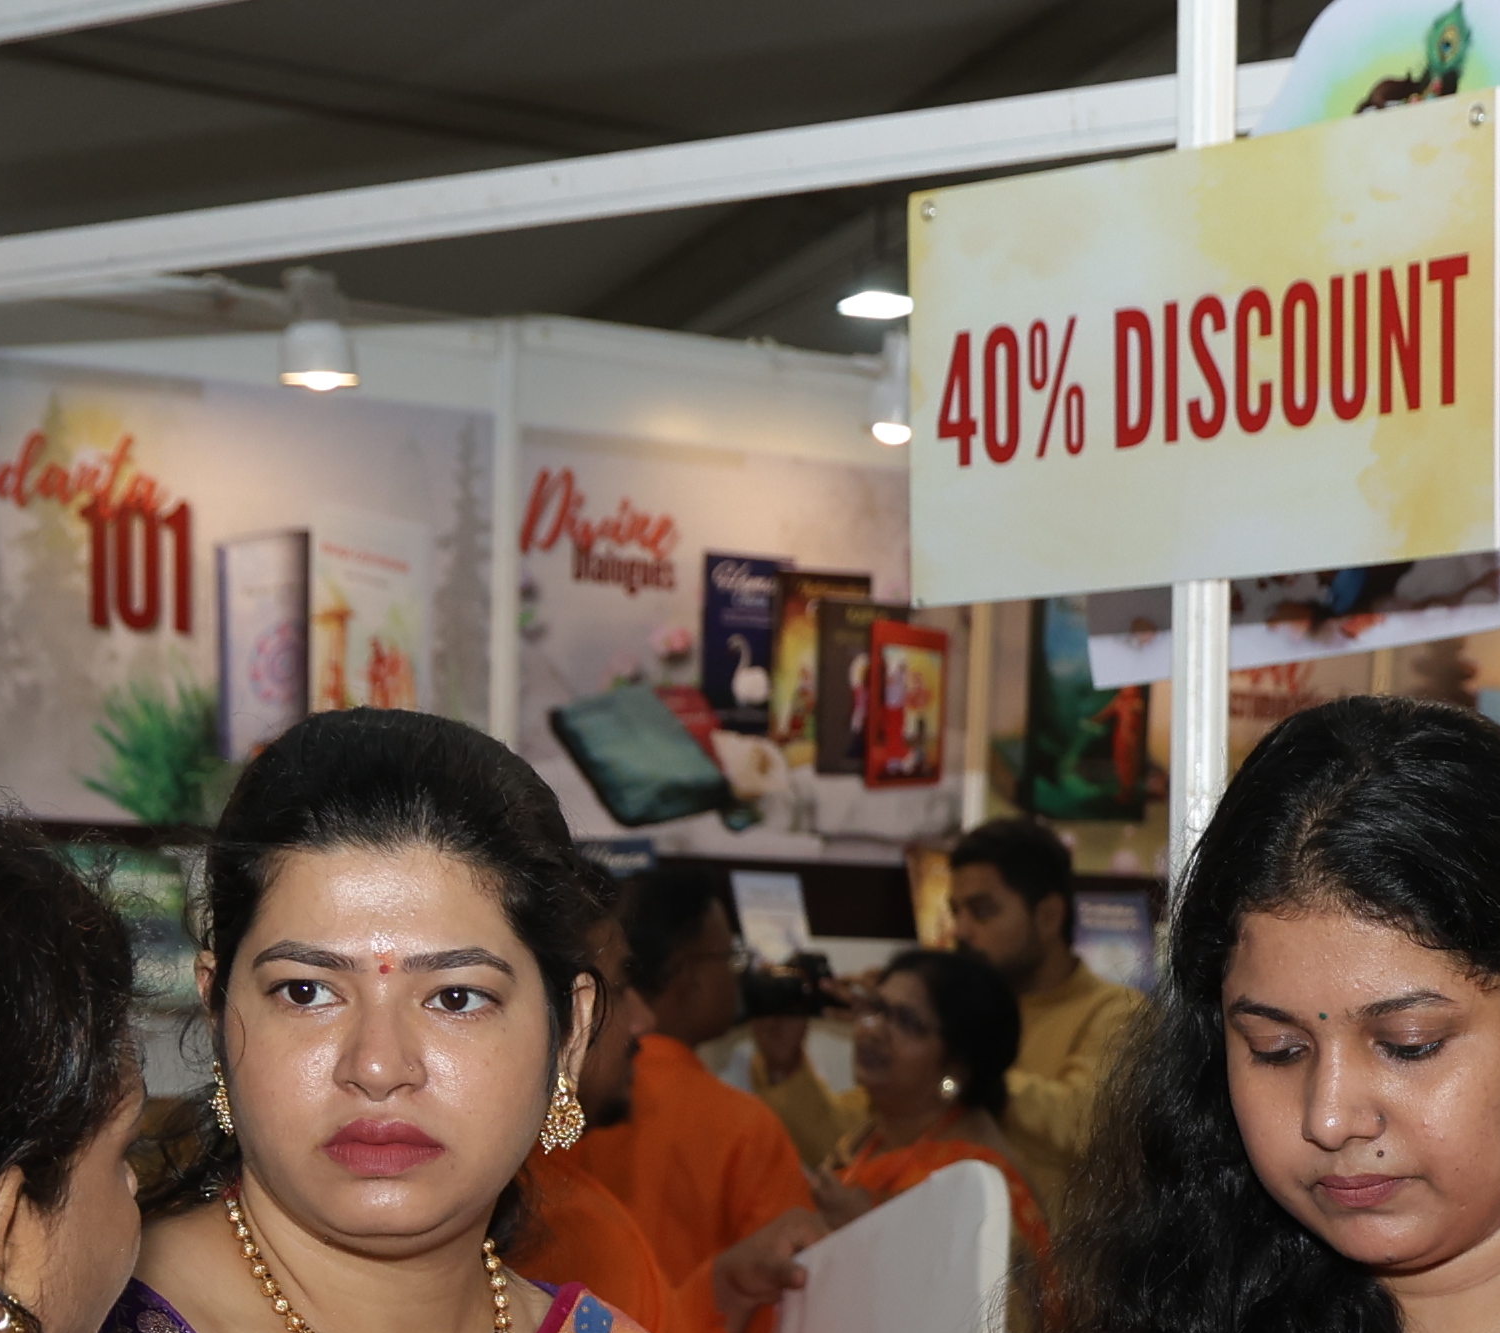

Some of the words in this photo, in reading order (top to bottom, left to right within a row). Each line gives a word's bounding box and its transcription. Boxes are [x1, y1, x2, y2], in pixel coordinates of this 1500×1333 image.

[936, 314, 1086, 468] 40%
[1113, 252, 1470, 450] DISCOUNT
[80, 494, 195, 637] 101
[518, 466, 681, 560] Divine
